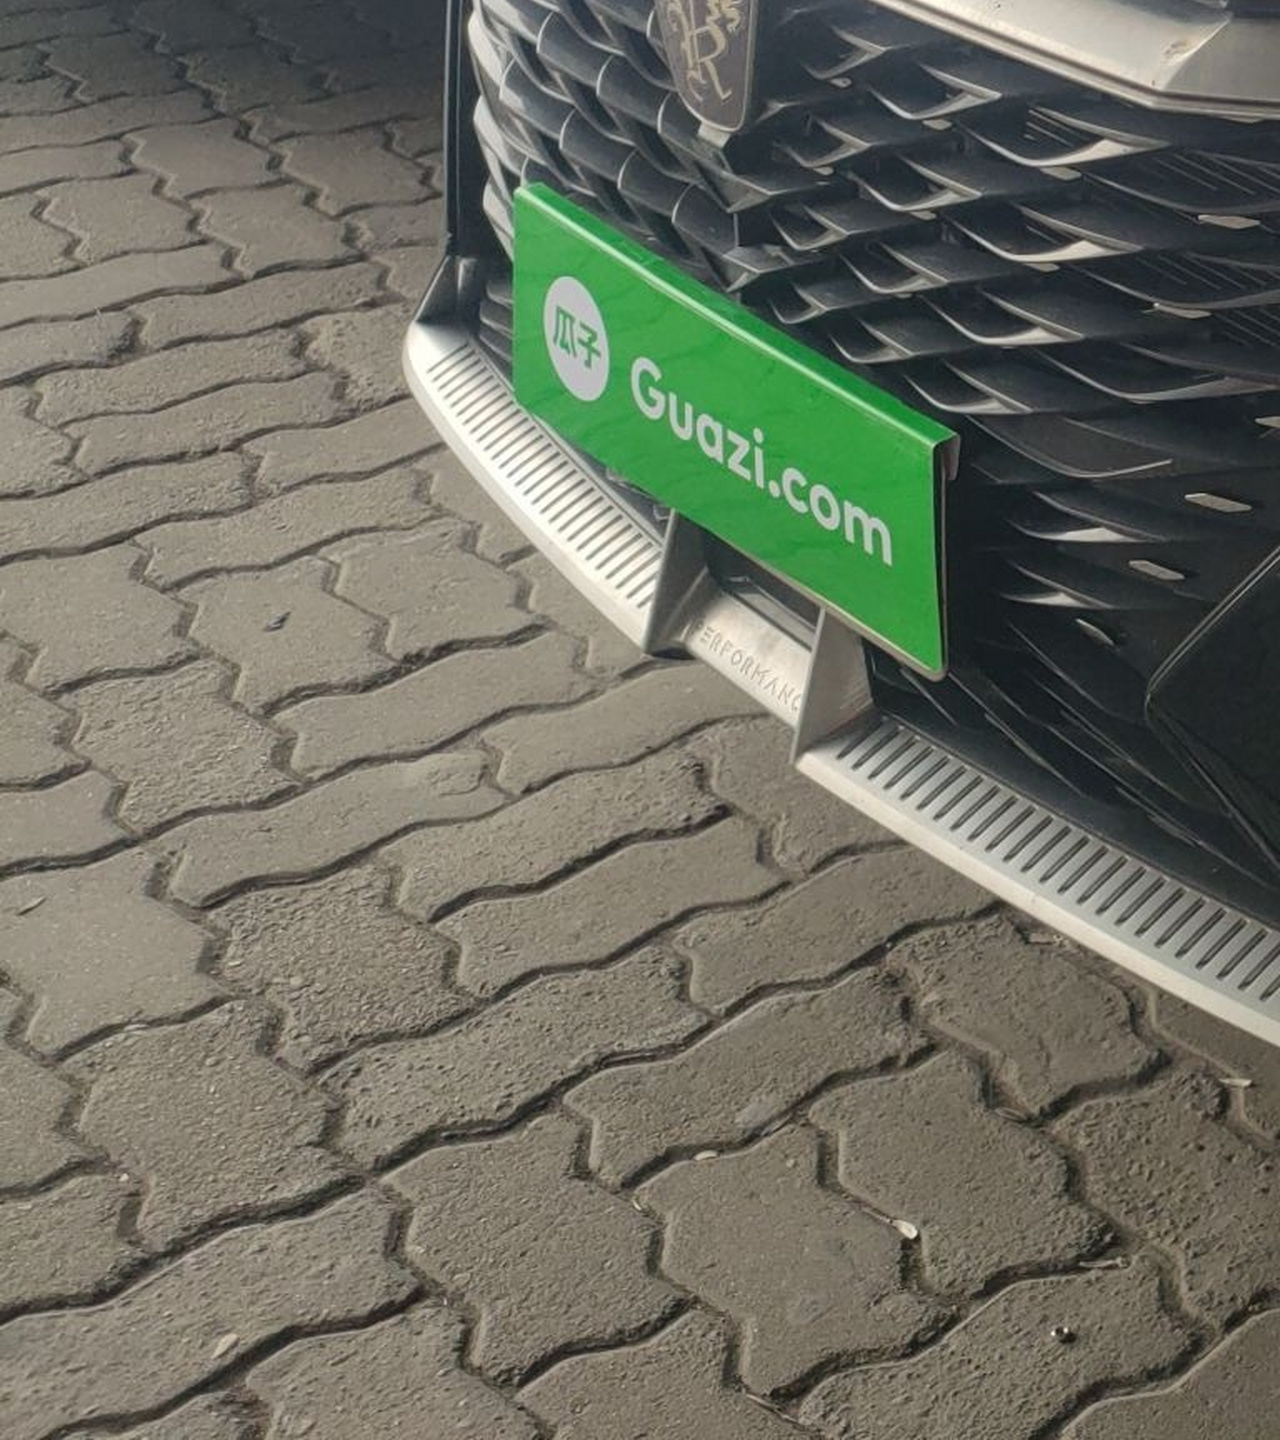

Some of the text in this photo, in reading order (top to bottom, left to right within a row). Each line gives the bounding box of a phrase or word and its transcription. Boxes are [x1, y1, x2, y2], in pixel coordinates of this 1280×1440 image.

[552, 305, 602, 371] 瓜子
[629, 355, 894, 568] Guazi.com
[691, 619, 802, 712] PERFORMANC
